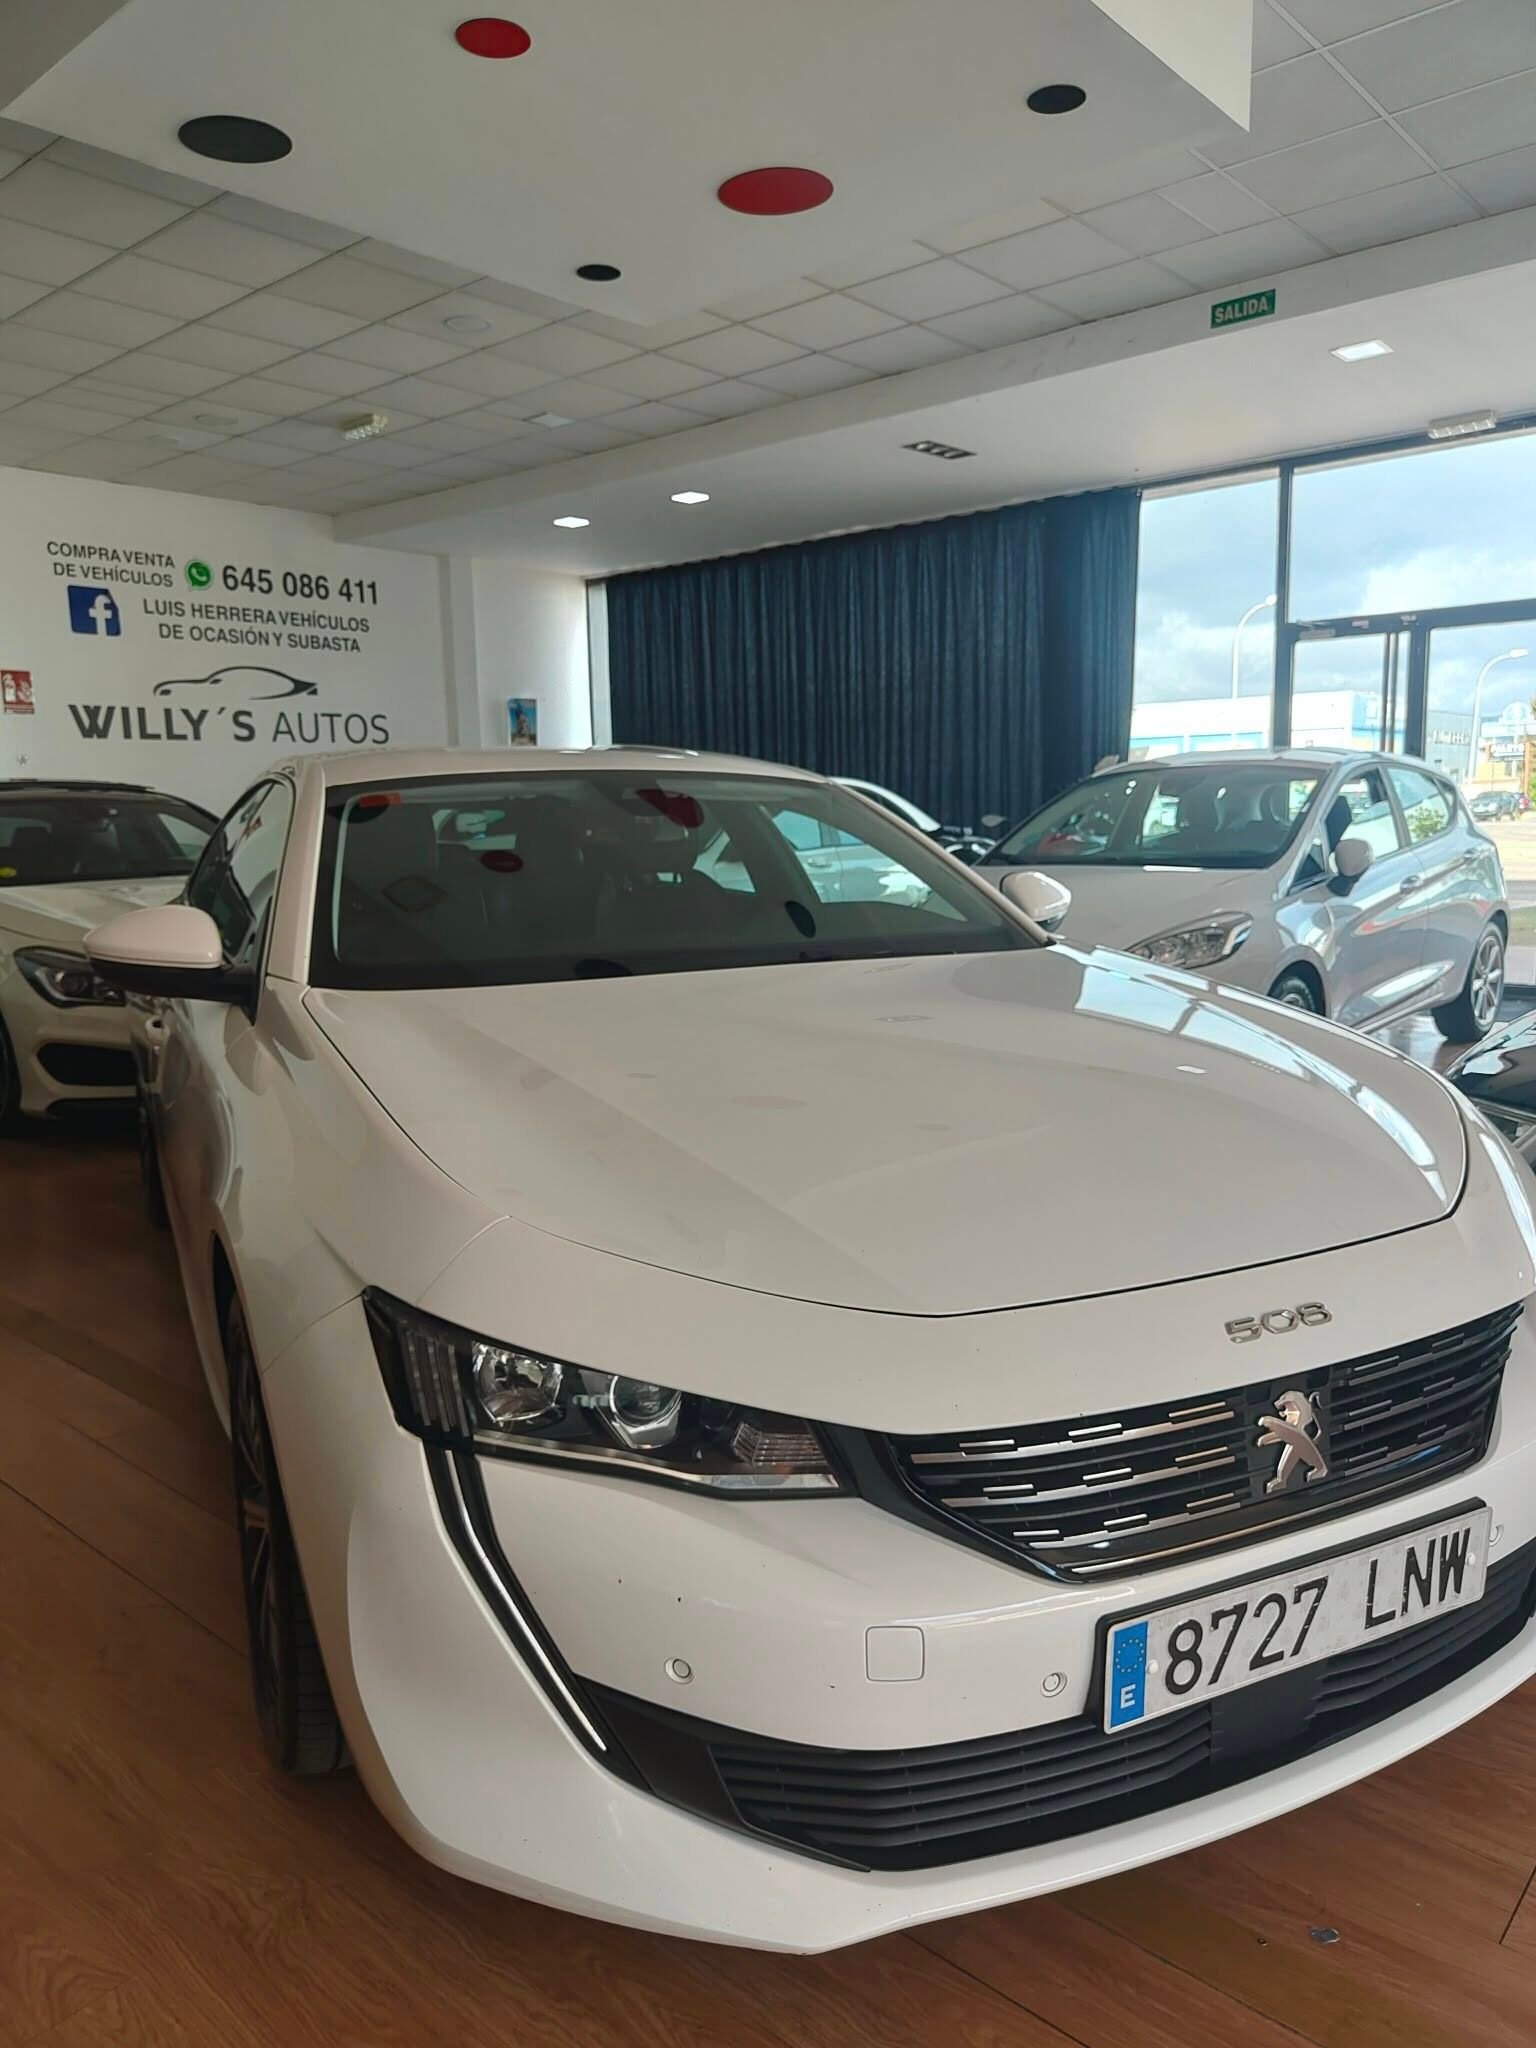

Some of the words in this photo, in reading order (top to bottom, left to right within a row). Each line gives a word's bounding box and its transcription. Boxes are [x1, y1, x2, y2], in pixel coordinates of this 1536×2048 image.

[1215, 295, 1268, 323] SALIDA
[47, 541, 121, 563] COMPRA
[123, 549, 175, 569] VENTA
[53, 562, 77, 577] DE
[80, 564, 173, 588] VEHÍCULOS
[223, 565, 273, 594] 645
[282, 571, 329, 600] 086
[338, 577, 378, 605] 411
[144, 599, 185, 618] LUIS
[191, 603, 277, 626] HERRERA
[278, 609, 370, 633] VEHÍCULOS
[159, 623, 184, 640] DE
[190, 626, 269, 646] OCASIÓN
[272, 632, 283, 647] Y
[288, 633, 361, 653] SUBASTA
[272, 711, 390, 745] AUTOS
[1224, 1302, 1333, 1344] 508
[1165, 1575, 1329, 1695] 8727
[1364, 1527, 1472, 1629] LNW
[1119, 1683, 1136, 1710] E
